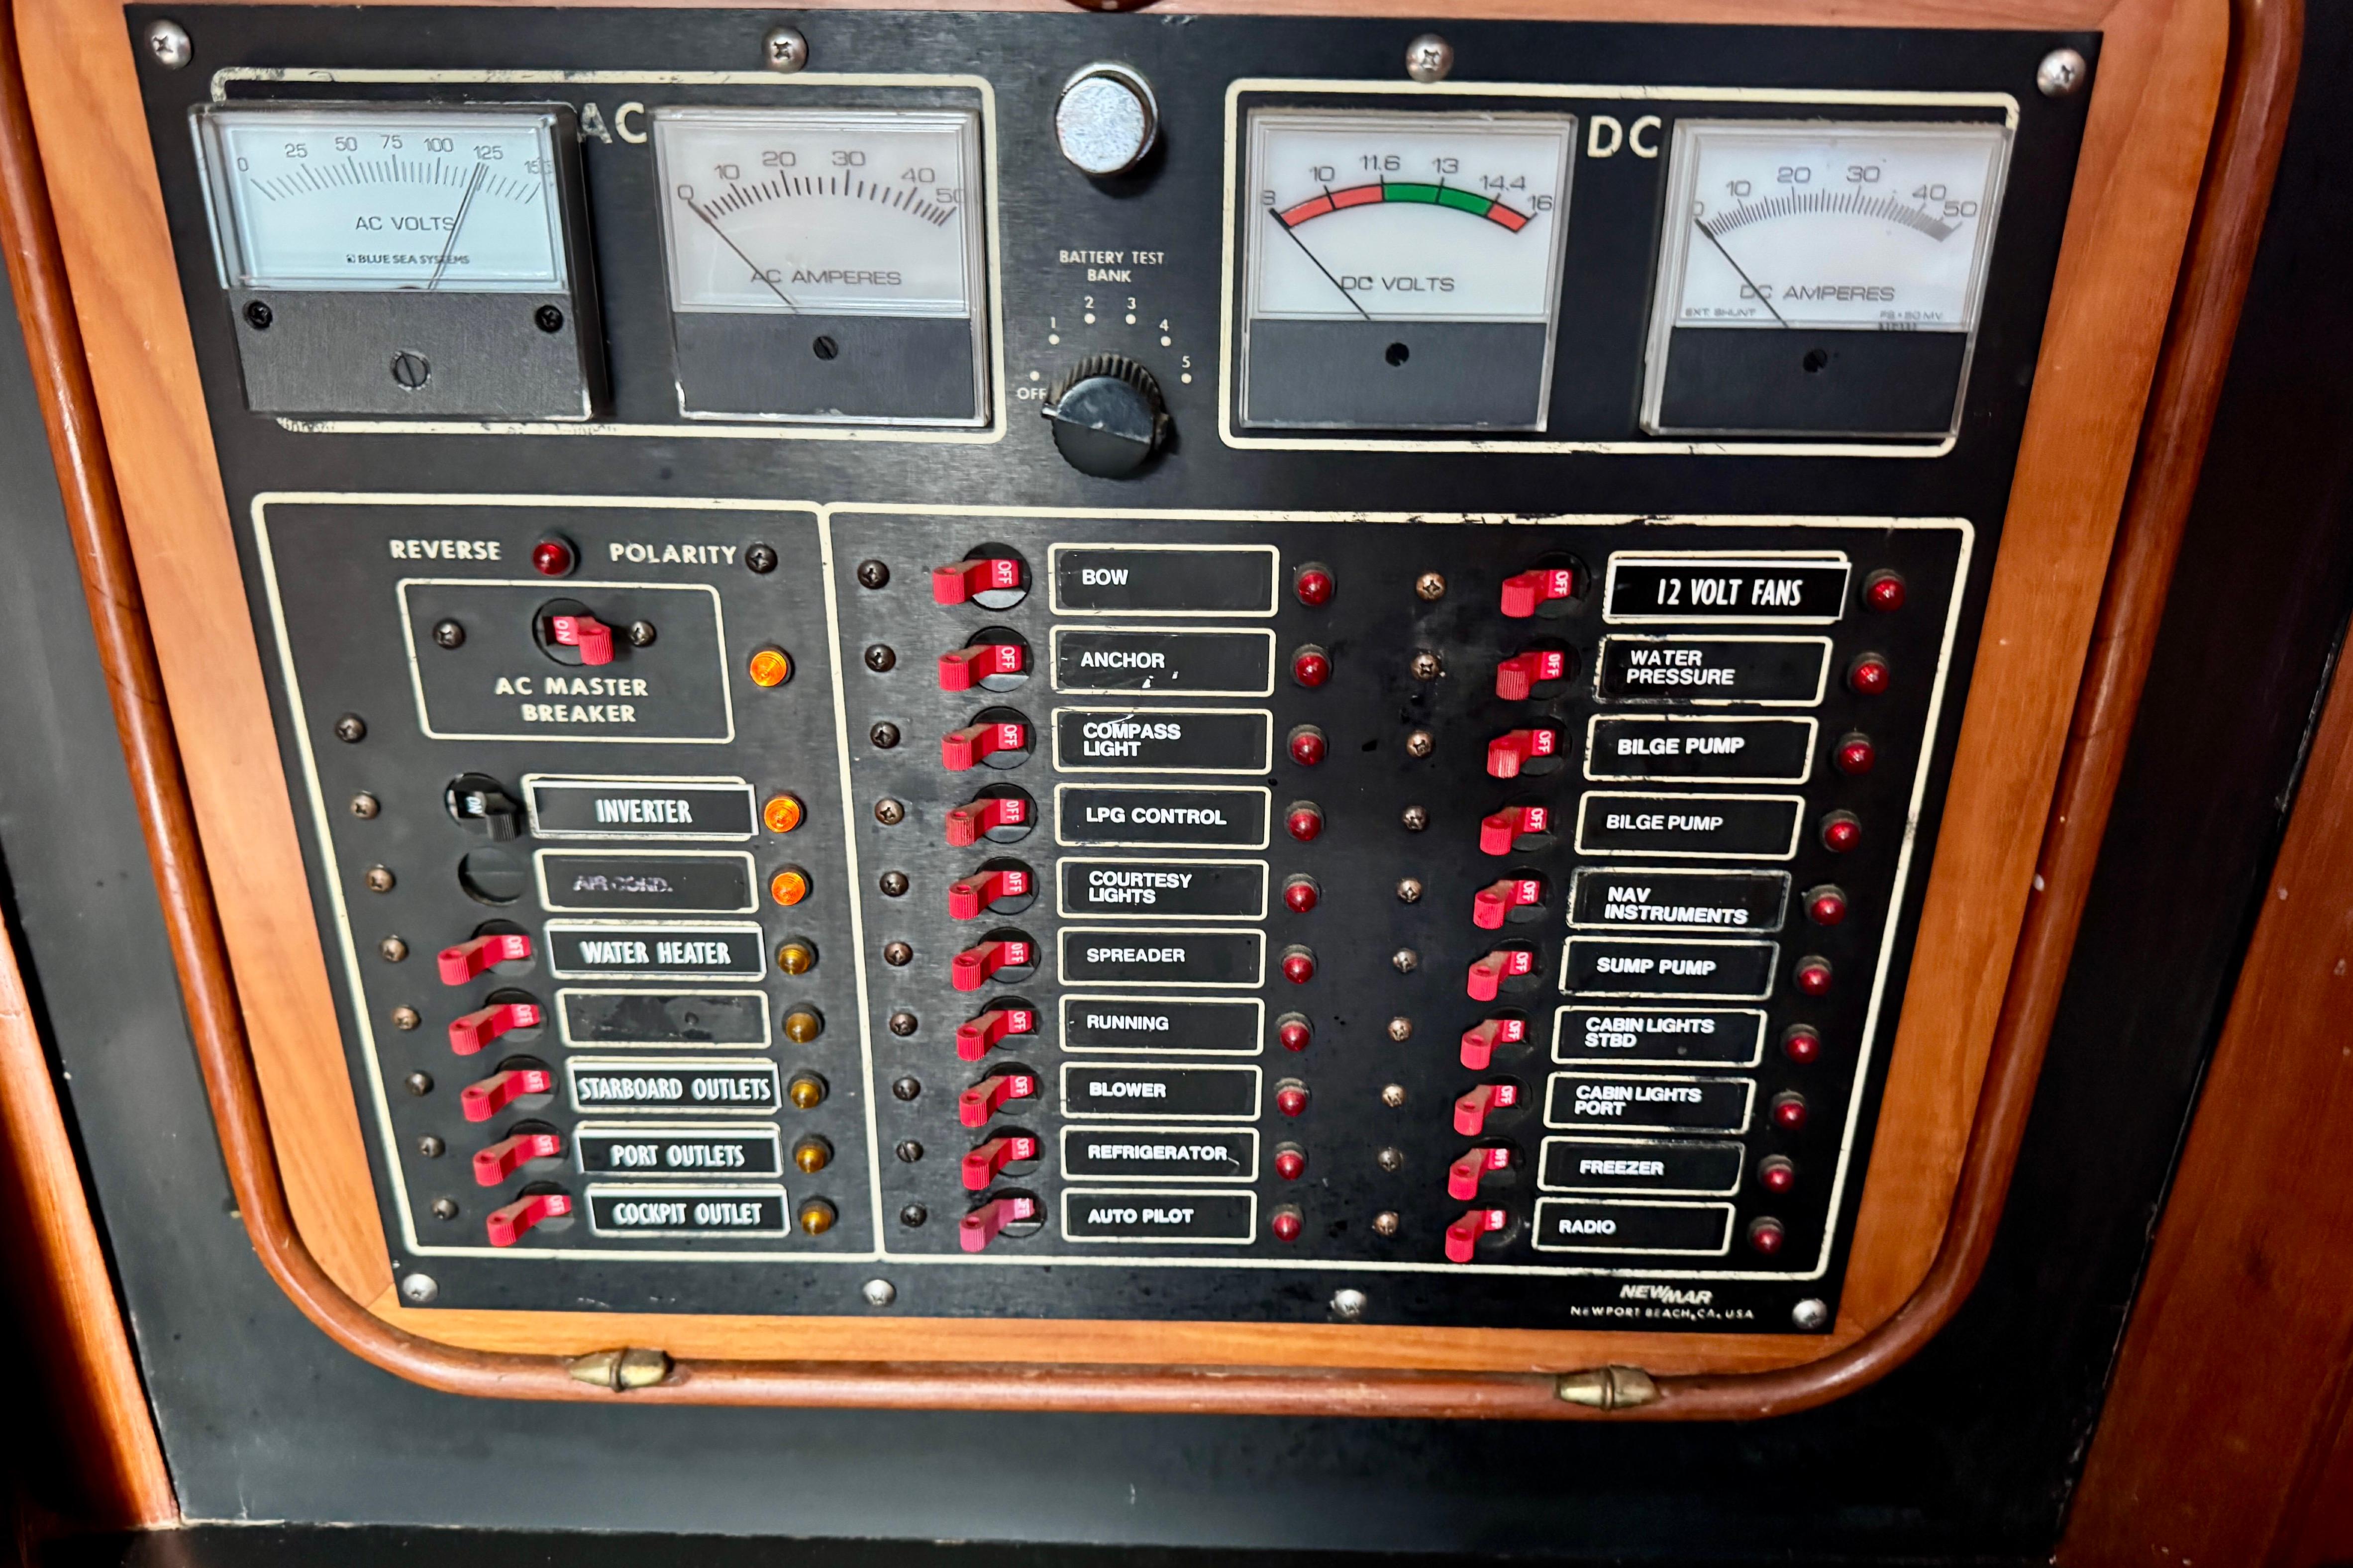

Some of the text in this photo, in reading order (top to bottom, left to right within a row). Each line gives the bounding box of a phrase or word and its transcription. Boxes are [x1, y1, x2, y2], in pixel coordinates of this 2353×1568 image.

[582, 101, 647, 144] AC
[335, 137, 357, 152] 50
[381, 135, 403, 149] 75
[424, 137, 453, 152] 100
[1587, 115, 1662, 158] DC
[285, 143, 307, 158] 25
[474, 146, 503, 160] 125
[762, 151, 796, 167] 20
[832, 151, 865, 166] 30
[237, 158, 248, 172] 0
[1359, 156, 1401, 171] 11.6
[1432, 158, 1458, 174] 13
[715, 165, 740, 180] 10
[901, 169, 935, 183] 40
[1309, 166, 1334, 182] 10
[1776, 167, 1811, 183] 20
[1846, 166, 1880, 183] 30
[1480, 175, 1526, 191] 14.4
[1725, 181, 1751, 196] 10
[678, 186, 694, 199] 0
[1912, 185, 1946, 200] 40
[1528, 195, 1552, 210] 16
[1944, 201, 1977, 217] 50
[356, 216, 455, 231] AC VOLTS
[358, 254, 390, 264] BLUE
[393, 254, 417, 264] SEA
[1060, 250, 1164, 264] BATTERY TEST
[751, 270, 901, 285] AC AMPERES
[1087, 269, 1131, 283] BANK
[1341, 277, 1454, 292] DC VOLTS
[1084, 295, 1094, 308] 2
[1740, 286, 1895, 300] DC AMPERES
[1127, 297, 1136, 309] 3
[1050, 316, 1056, 329] 1
[1159, 319, 1169, 331] 4
[1182, 356, 1191, 368] 5
[1017, 388, 1047, 400] OFF
[390, 540, 501, 560] REVERSE
[610, 543, 736, 565] POLARITY
[998, 561, 1013, 586] OFF
[1082, 569, 1128, 586] BOW
[1555, 571, 1569, 596] OFF
[1657, 579, 1803, 606] 12 VOLT FANS
[554, 619, 569, 642] ON
[1001, 647, 1016, 670] OFF
[1080, 652, 1165, 669] ANCHOR
[1548, 653, 1560, 678] OFF
[1631, 650, 1702, 666] WATER
[1627, 669, 1736, 685] PRESSURE
[495, 678, 648, 696] AC MASTER
[521, 704, 636, 722] BREAKER
[1003, 725, 1018, 747] OFF
[1083, 723, 1182, 740] COMPASS
[1084, 741, 1141, 757] LIGHT
[1538, 731, 1550, 753] OFF
[1618, 738, 1745, 755] BILGE PUMP
[468, 796, 482, 814] ON
[596, 799, 693, 823] INVERTER
[1005, 800, 1020, 822] OFF
[1086, 807, 1227, 825] LPG CONTROL
[1531, 808, 1542, 829] OFF
[1606, 814, 1723, 831] BILGE PUMP
[1008, 872, 1023, 894] OFF
[1089, 871, 1192, 888] COURTESY
[1089, 887, 1156, 904] LIGHTS
[1524, 881, 1535, 903] OFF
[1608, 886, 1651, 903] NAV
[1604, 904, 1748, 924] INSTRUMENTS
[507, 936, 524, 955] OFF
[579, 941, 731, 965] WATER HEATER
[1011, 943, 1024, 965] OFF
[1086, 948, 1185, 963] SPREADER
[1516, 952, 1528, 973] OFF
[1596, 957, 1717, 976] SUMP PUMP
[516, 1005, 534, 1025] OFF
[1013, 1011, 1026, 1032] OFF
[1087, 1015, 1169, 1031] RUNNING
[1509, 1019, 1521, 1040] OFF
[1586, 1017, 1714, 1034] CABIN LIGHTS
[1585, 1033, 1637, 1047] STBD
[527, 1071, 544, 1091] OFF
[577, 1078, 771, 1100] STARBOARD OUTLETS
[1015, 1076, 1028, 1096] OFF
[1090, 1082, 1166, 1098] BLOWER
[1501, 1085, 1513, 1104] OFF
[1575, 1085, 1702, 1102] CABIN LIGHTS
[1574, 1100, 1626, 1116] PORT
[537, 1136, 554, 1156] OFF
[1017, 1139, 1029, 1158] OFF
[1088, 1146, 1227, 1161] REFRIGERATOR
[610, 1145, 745, 1167] PORT OUTLETS
[1579, 1160, 1664, 1176] FREEZER
[613, 1202, 761, 1225] COCKPIT OUTLET
[1088, 1209, 1194, 1223] AUTO PILOT
[1558, 1219, 1617, 1234] RADIO
[1570, 1306, 1640, 1317] NEWPORT
[1725, 1309, 1754, 1319] USA
